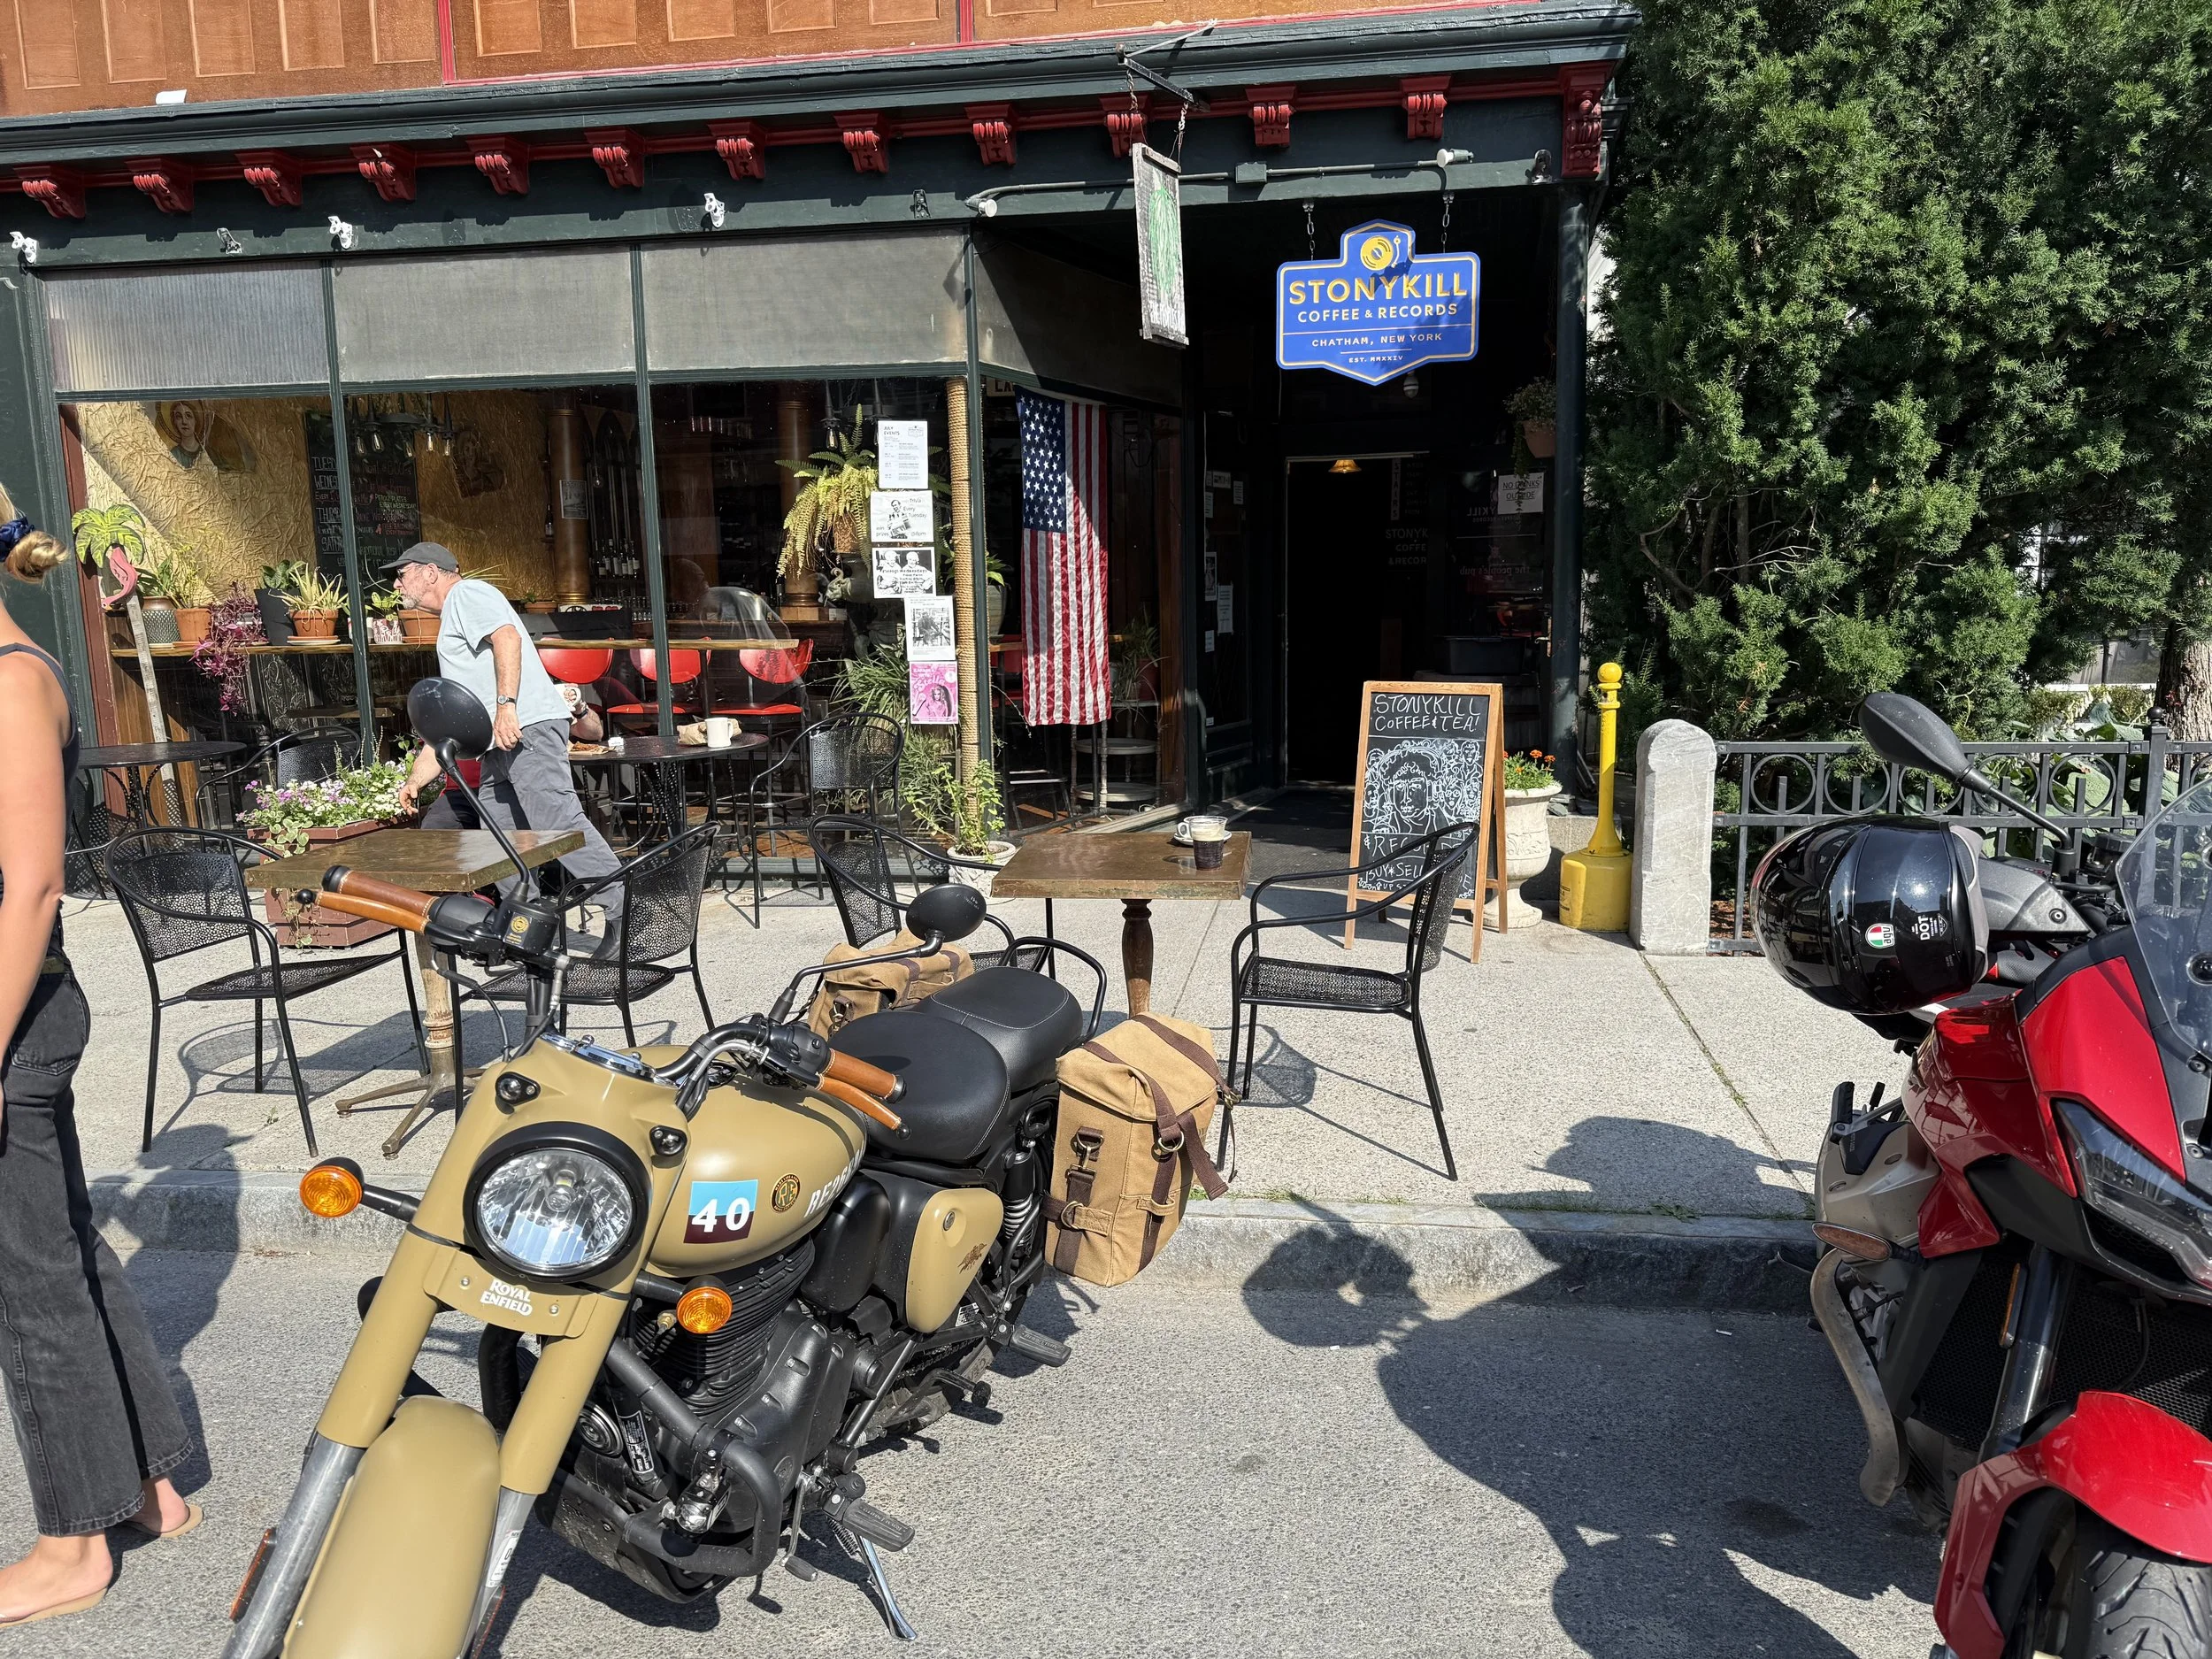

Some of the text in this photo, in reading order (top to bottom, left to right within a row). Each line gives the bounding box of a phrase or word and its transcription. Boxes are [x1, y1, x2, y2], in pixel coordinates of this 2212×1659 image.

[1289, 272, 1467, 304] STONYKILL
[1298, 303, 1457, 323] COFFEE & RECORDS
[1311, 333, 1442, 347] CHATHAM, NEW YORK
[1374, 694, 1481, 717] STONYKILL
[1883, 926, 1893, 944] agv
[1917, 915, 1930, 941] DOT
[691, 1197, 750, 1233] 40
[489, 1279, 532, 1302] ROYAL
[480, 1291, 533, 1316] ENFIELD
